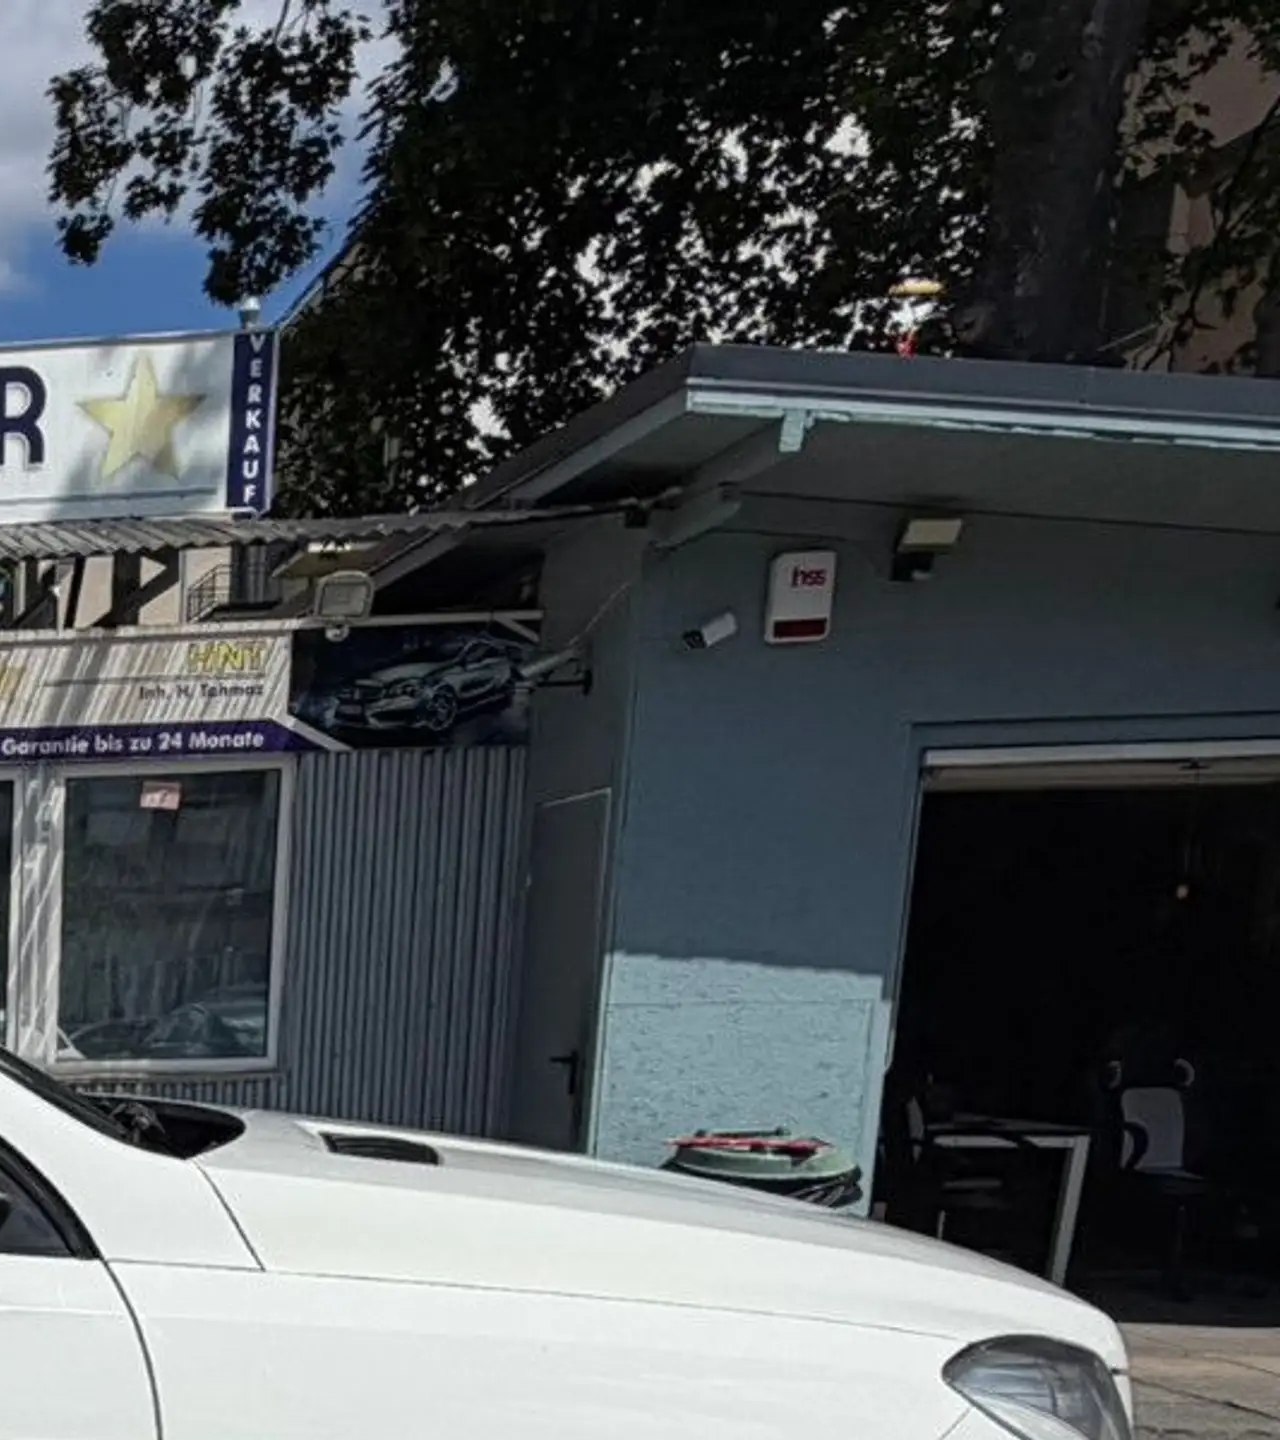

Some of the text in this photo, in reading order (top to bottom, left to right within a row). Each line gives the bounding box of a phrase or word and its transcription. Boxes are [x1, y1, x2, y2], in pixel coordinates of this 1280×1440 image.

[243, 333, 266, 503] VERKAUF
[0, 730, 265, 758] Garantie bis zu 24 Monate
